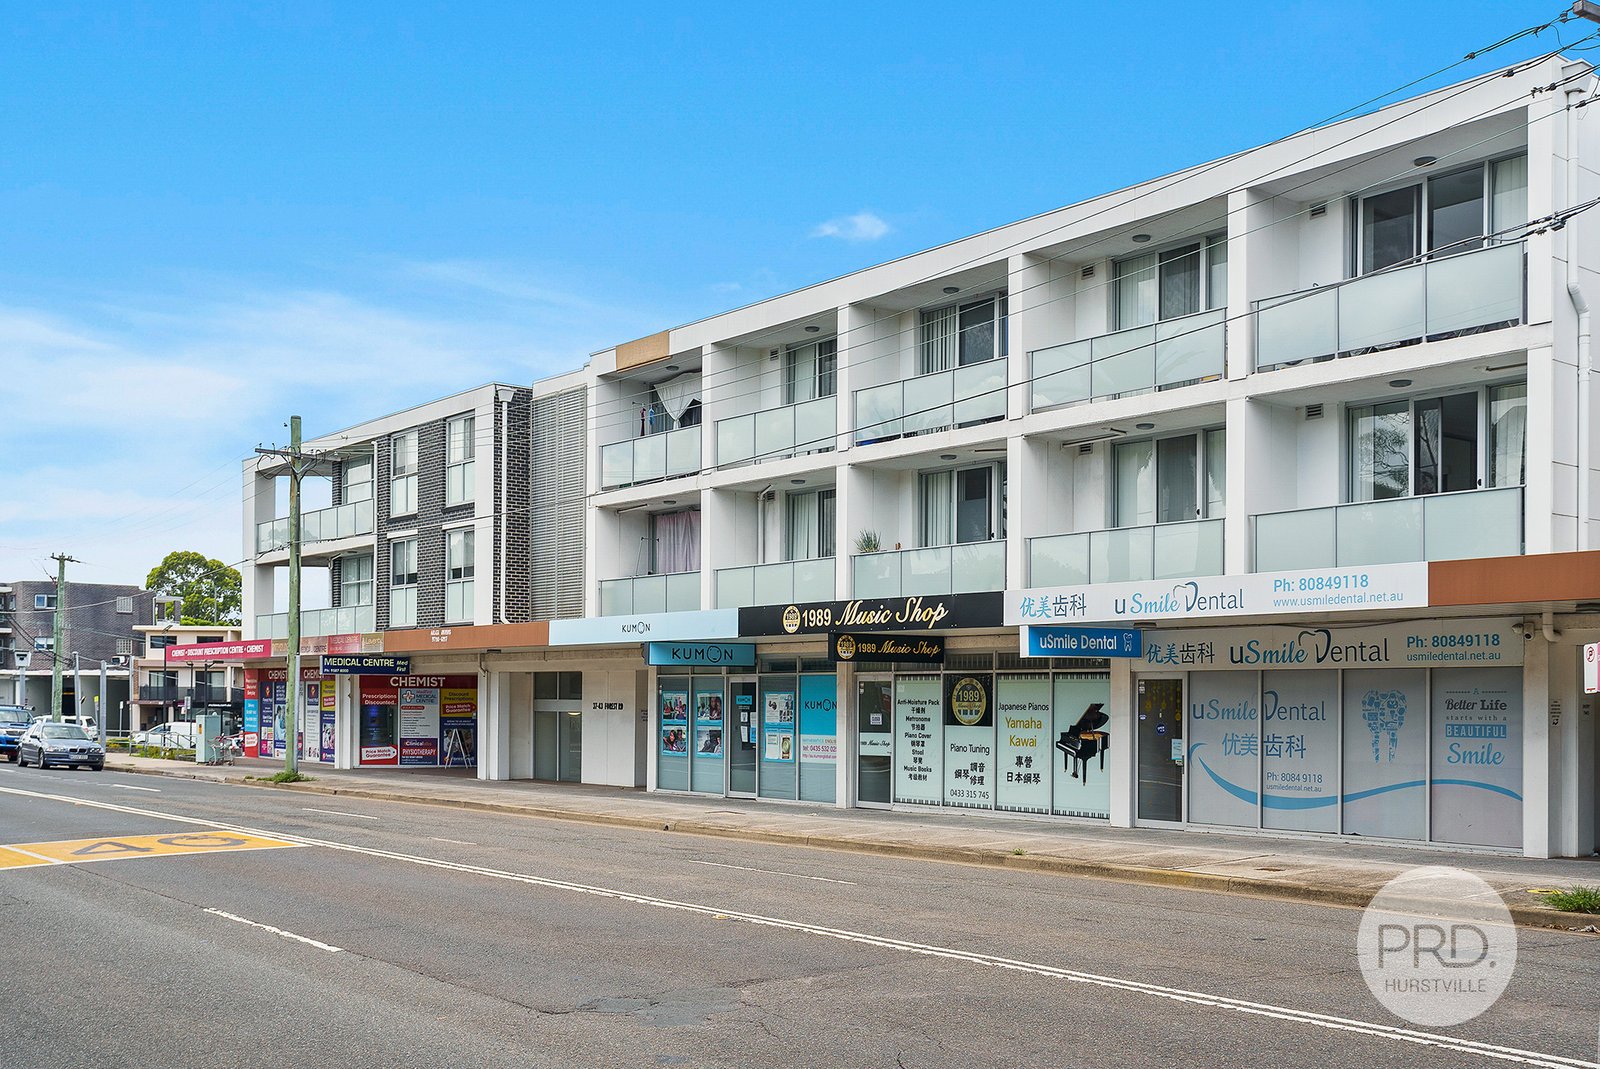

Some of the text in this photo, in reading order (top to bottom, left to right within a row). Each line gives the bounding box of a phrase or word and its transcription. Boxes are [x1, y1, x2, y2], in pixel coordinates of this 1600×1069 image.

[1274, 574, 1369, 592] Ph: 80849118
[1184, 581, 1244, 612] Dental
[1274, 592, 1404, 606] www.usmiledental.net.au
[1020, 593, 1086, 618] 优美齿科
[802, 597, 948, 629] 1989 Music Shop
[622, 622, 650, 634] KUMON
[1040, 633, 1117, 650] uSmile Dental
[1230, 628, 1390, 664] uSmile Dental
[1407, 634, 1500, 648] Ph: 80849118
[672, 646, 733, 663] KUMON
[858, 640, 940, 656] 1989 Music Shop
[1146, 641, 1215, 664] 优美齿科
[324, 658, 361, 666] MEDICAL
[363, 659, 394, 667] CENTRE
[1406, 651, 1500, 661] usmiledental.net.au
[390, 677, 446, 687] CHEMIST
[959, 690, 980, 701] 1989
[804, 699, 837, 711] KUMON
[999, 703, 1049, 711] Japanese Pianos
[1192, 691, 1326, 721] uSmile Dental
[1445, 698, 1507, 710] Better Life
[1005, 716, 1042, 729] Yamaha
[1447, 725, 1505, 737] BEAUTIFUL
[1010, 735, 1037, 747] Kawai
[950, 743, 990, 756] Piano Tuning
[1447, 742, 1505, 765] Smile
[1267, 772, 1323, 783] Ph: 8084 9118
[950, 789, 989, 799] 0433 315 745
[1266, 784, 1322, 792] usmiledental.net.au
